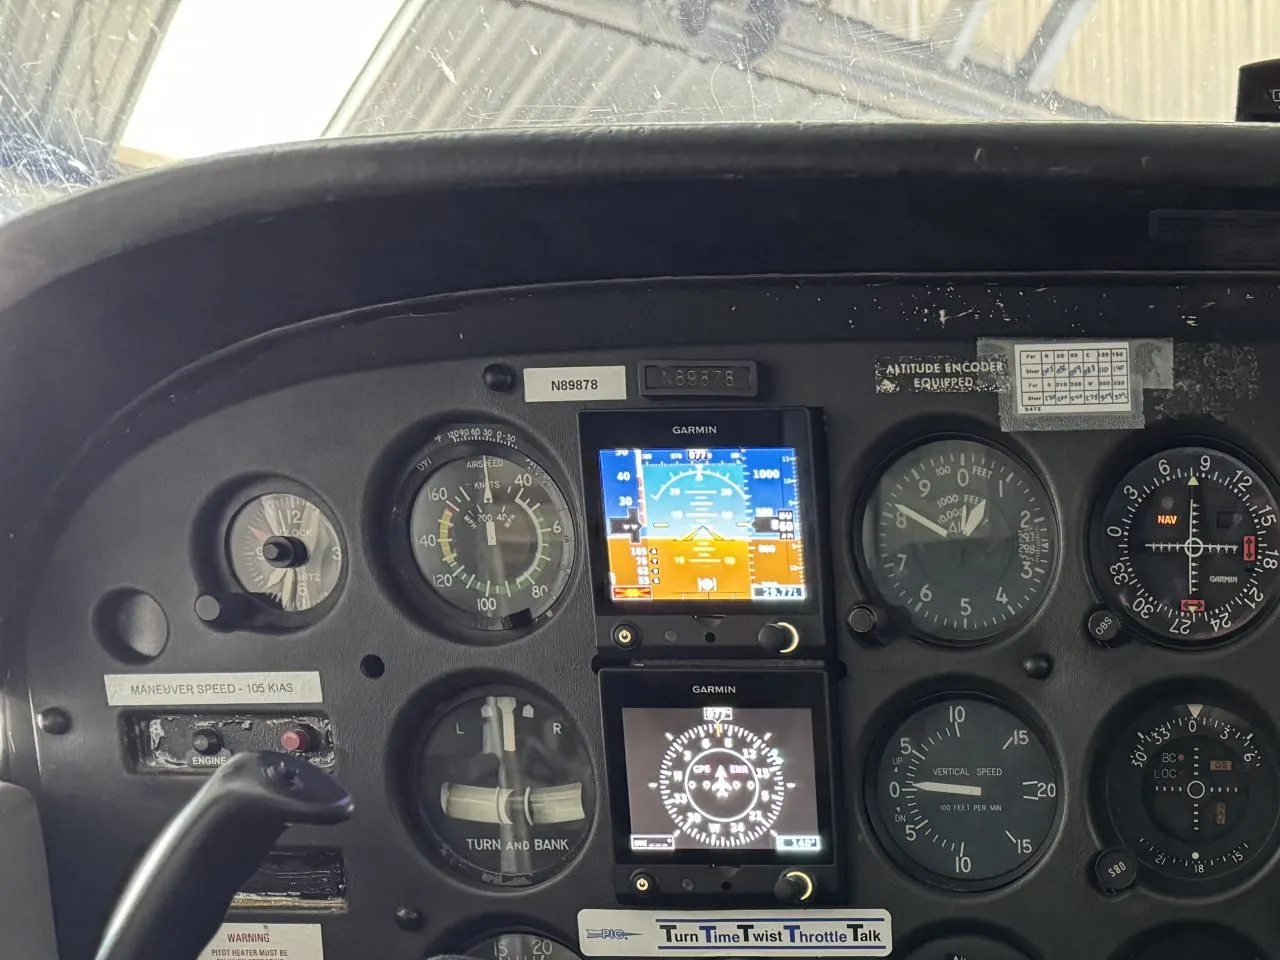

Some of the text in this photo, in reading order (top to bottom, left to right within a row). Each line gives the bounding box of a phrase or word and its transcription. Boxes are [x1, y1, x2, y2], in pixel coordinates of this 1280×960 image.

[886, 361, 1004, 374] ALTITUDE ENCODER
[551, 379, 598, 391] N89878
[914, 377, 974, 389] EQUIPPED
[672, 425, 718, 434] GARMIN
[1232, 470, 1252, 492] 12
[1157, 515, 1178, 525] NAV
[1258, 504, 1276, 526] 15
[1263, 550, 1280, 569] 18
[433, 575, 453, 588] 120
[1209, 575, 1238, 584] GARMIN
[477, 597, 498, 611] 100
[1243, 586, 1264, 609] 21
[1096, 616, 1112, 636] OBS
[131, 684, 194, 696] MANEUVER
[197, 683, 236, 695] SPEED
[247, 683, 265, 694] 105
[268, 682, 294, 693] KIAS
[692, 685, 736, 694] GARMIN
[192, 756, 227, 766] ENGINE
[932, 768, 1003, 776] VERTICAL SPEED
[467, 839, 569, 851] TURN AND BANK
[227, 933, 270, 943] WARNING
[660, 925, 699, 943] Turn
[700, 925, 741, 944] Time
[737, 924, 783, 943] Twist
[784, 925, 849, 944] Throttle
[847, 924, 882, 943] Talk
[211, 949, 288, 957] PITOT HEATER MUST BE
[494, 941, 508, 957] 15
[533, 940, 553, 955] 20
